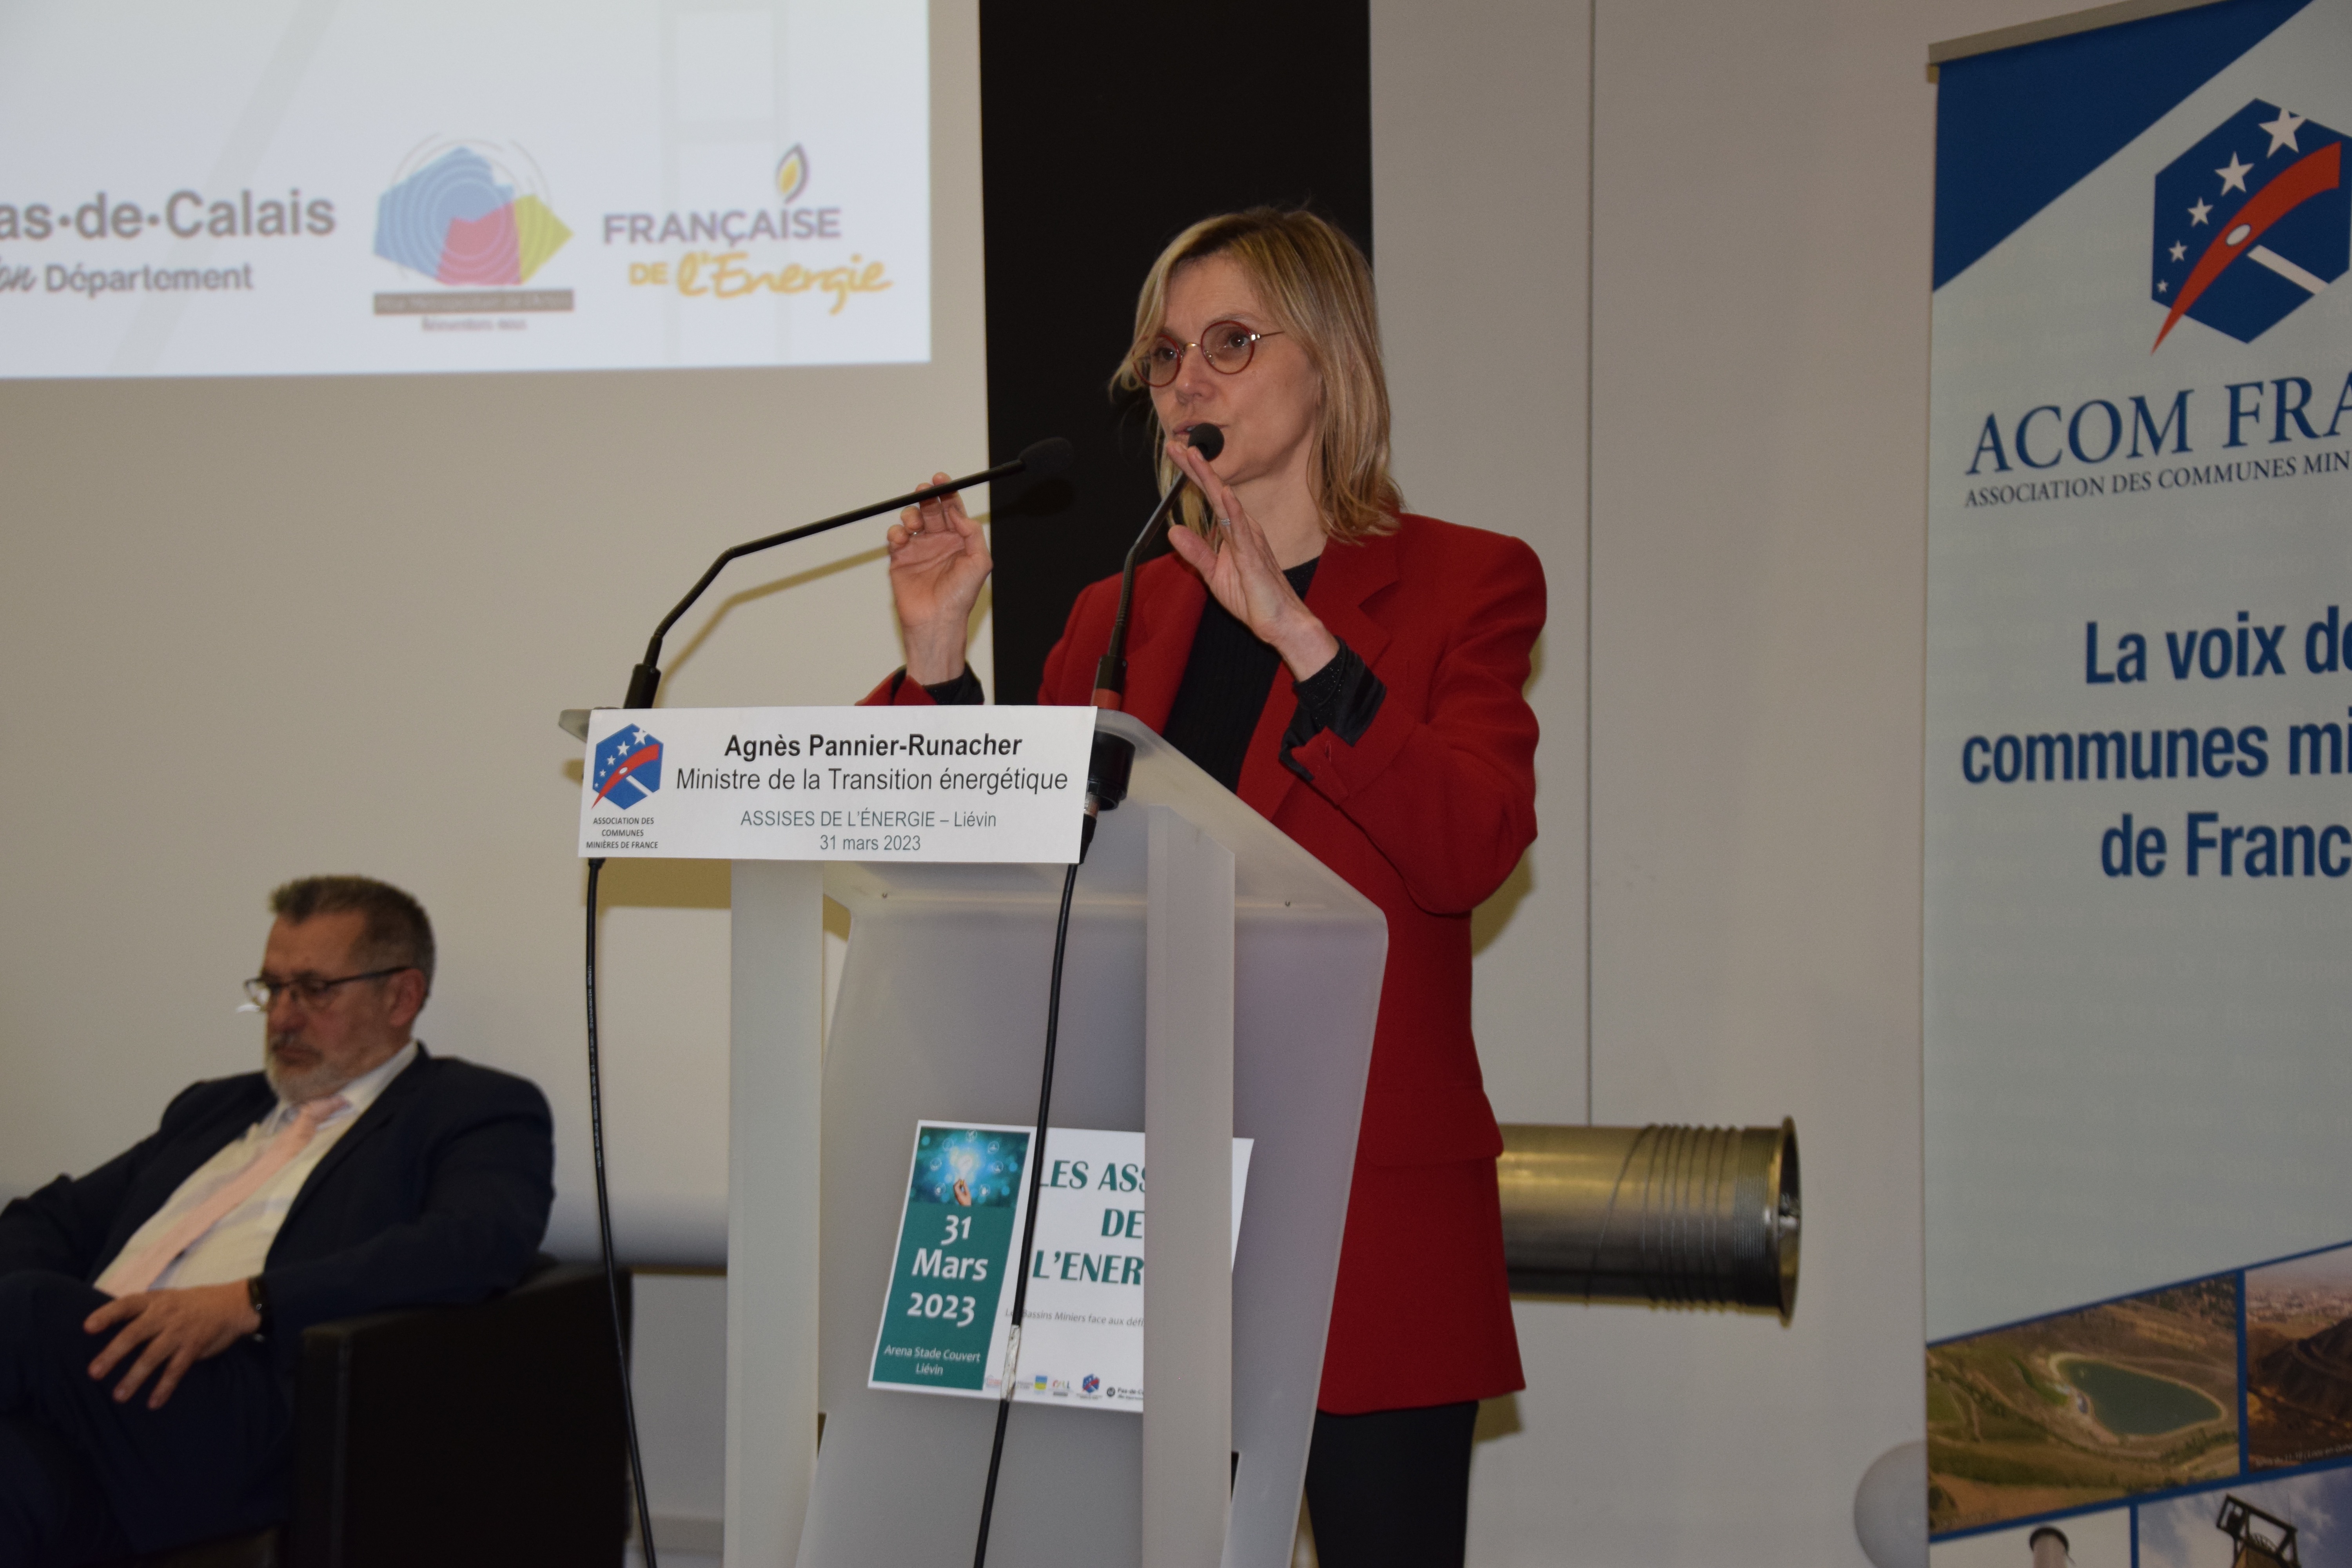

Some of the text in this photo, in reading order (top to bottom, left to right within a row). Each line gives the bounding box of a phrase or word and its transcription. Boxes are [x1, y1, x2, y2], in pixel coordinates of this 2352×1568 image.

[0, 189, 335, 241] as·de·Calais
[603, 208, 840, 248] FRANÇAISE
[0, 263, 252, 299] on Département
[629, 262, 668, 285] DE
[1966, 389, 2195, 475] ACOM
[1965, 450, 2352, 507] ASSOCIATION DES COMMUNES MIN
[2086, 622, 2146, 684] La
[2166, 611, 2286, 680] voix
[724, 733, 1022, 762] Agnès Pannier-Runacher
[1963, 726, 2269, 784] communes
[677, 768, 1067, 795] Ministre de la Transition énergétique
[741, 811, 815, 826] ASSISES
[821, 811, 842, 826] DE
[849, 806, 935, 828] L'ÉNERGIE
[955, 811, 996, 827] Liévin
[820, 835, 920, 851] 31 mars 2023
[2102, 812, 2352, 878] de Franc
[1040, 1160, 1145, 1192] ES AS
[941, 1215, 971, 1245] 31
[1102, 1209, 1145, 1238] DE
[912, 1248, 988, 1281] Mars
[1033, 1250, 1144, 1285] L'ENER
[907, 1292, 975, 1327] 2023
[1055, 1312, 1085, 1322] Miniers
[1089, 1314, 1106, 1324] face
[1127, 1317, 1144, 1327] défi
[884, 1345, 980, 1362] Arena Stade Couvert
[916, 1363, 943, 1375] Liévin
